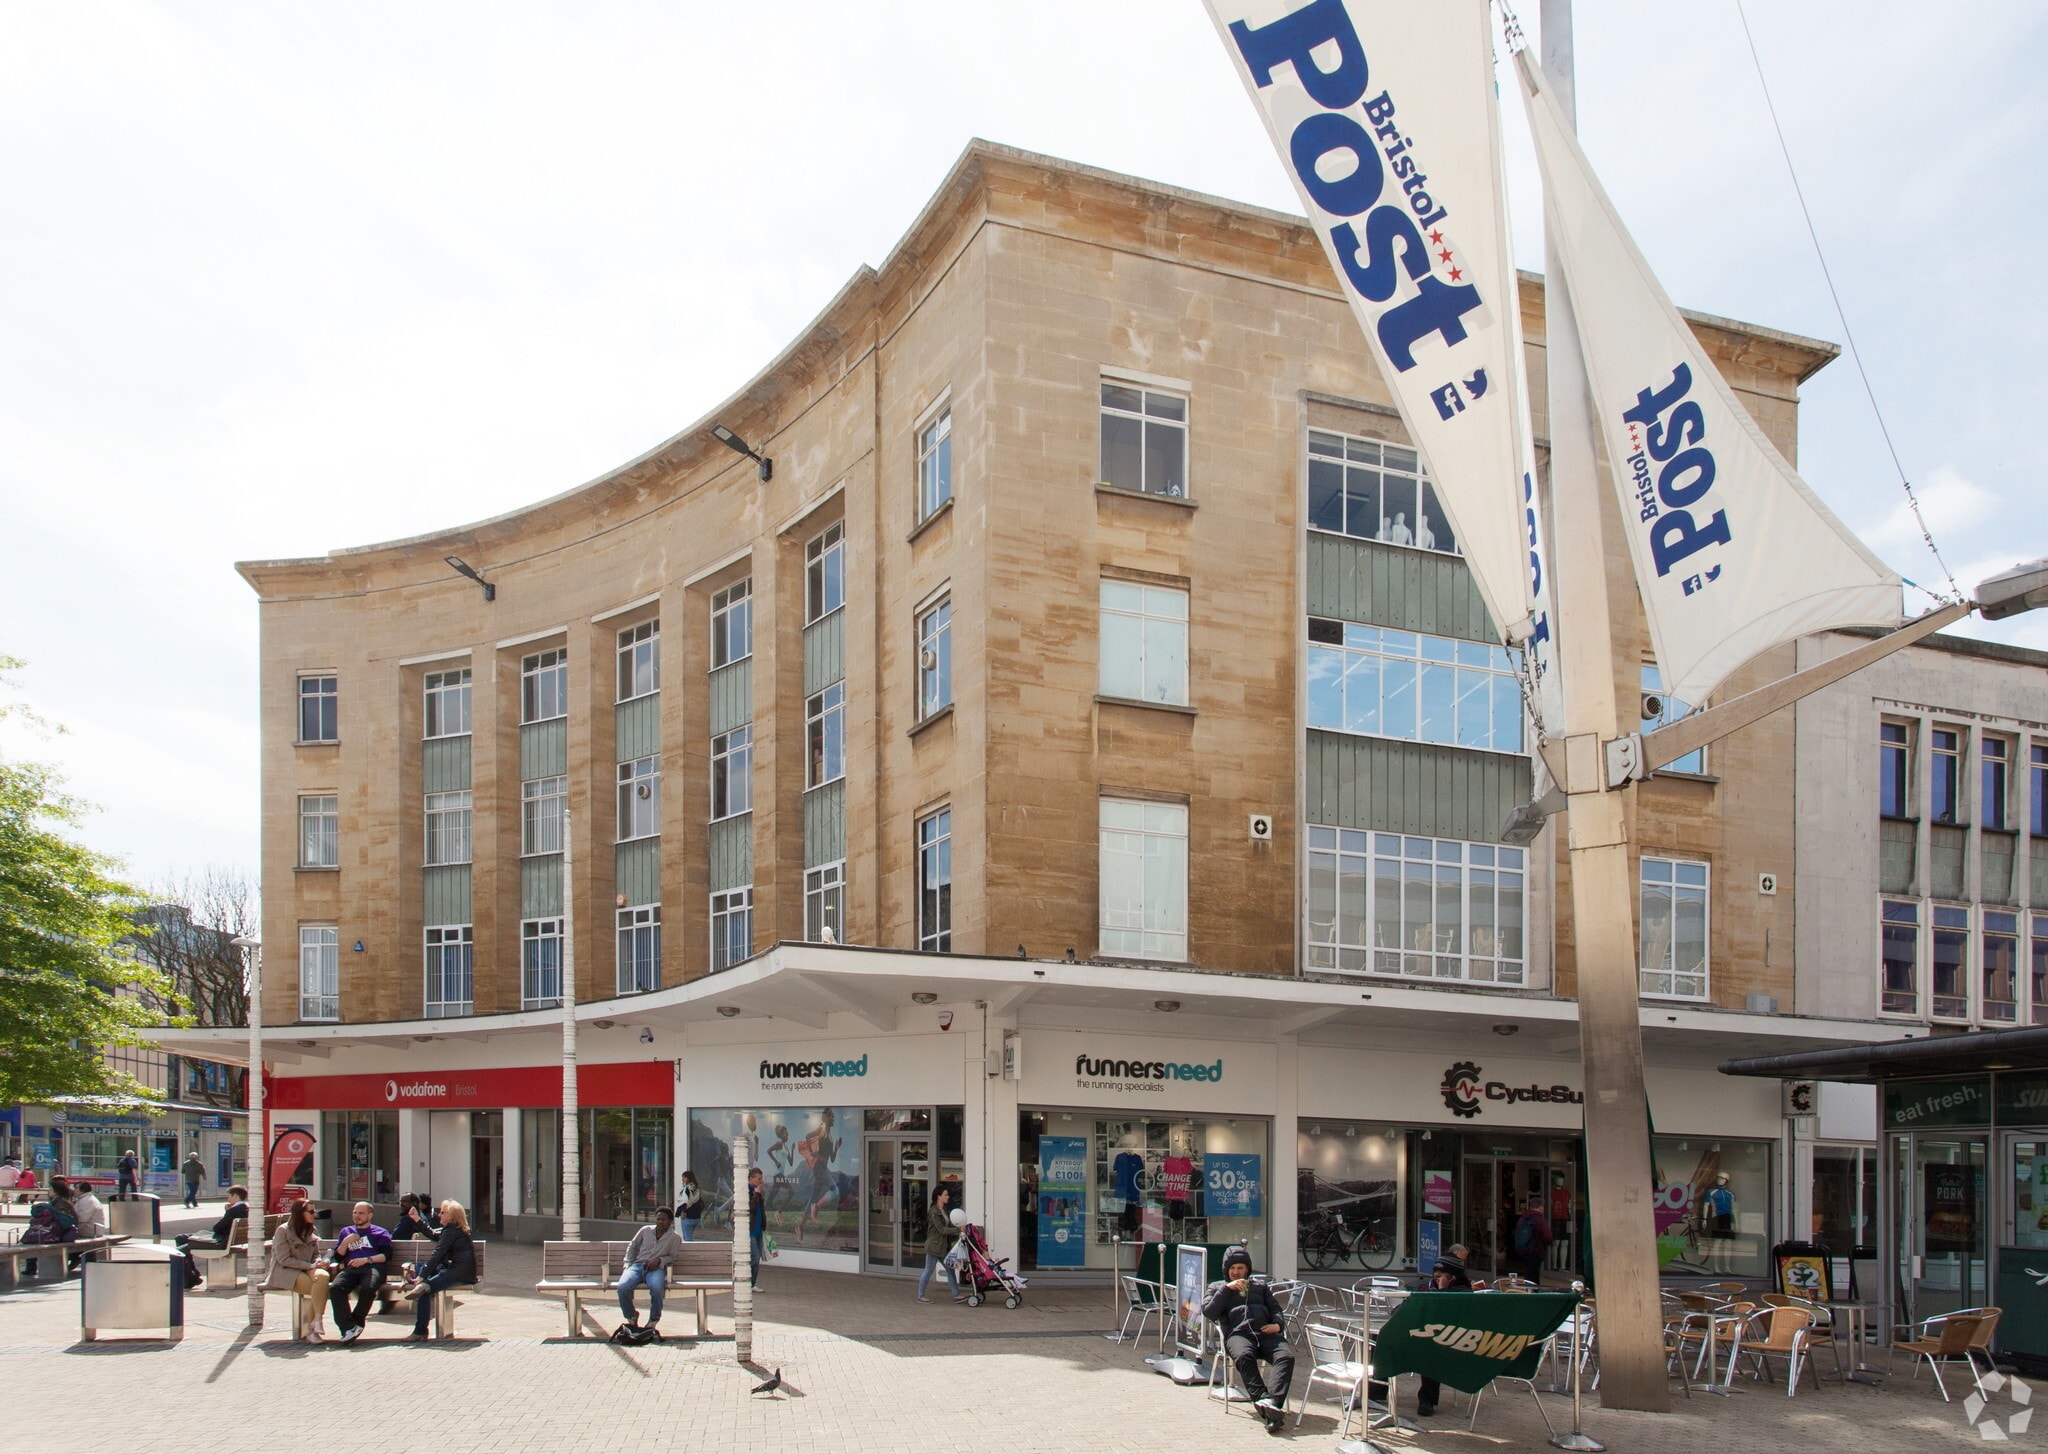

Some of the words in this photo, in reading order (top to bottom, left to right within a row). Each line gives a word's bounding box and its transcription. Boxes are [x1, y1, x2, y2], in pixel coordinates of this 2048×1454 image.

[1362, 90, 1447, 231] Bristol
[1228, 0, 1482, 373] Post
[1622, 361, 1732, 577] Post
[1626, 451, 1659, 523] Bristol
[760, 1053, 868, 1079] runnersneed
[1076, 1054, 1222, 1083] runnersneed
[400, 1081, 446, 1097] vodafone
[455, 1083, 478, 1096] Bristol
[761, 1081, 771, 1090] the
[771, 1081, 793, 1092] running
[794, 1080, 824, 1091] specialists
[1077, 1079, 1090, 1089] the
[1092, 1080, 1122, 1092] running
[1124, 1081, 1164, 1092] specialists
[1895, 1102, 1925, 1123] eat
[1926, 1085, 1983, 1113] fresh.
[1156, 1173, 1192, 1183] CHANGE
[1169, 1182, 1190, 1191] TIME
[1237, 1180, 1256, 1189] OFF
[1936, 1186, 1964, 1200] PORK
[1787, 1268, 1822, 1287] £2
